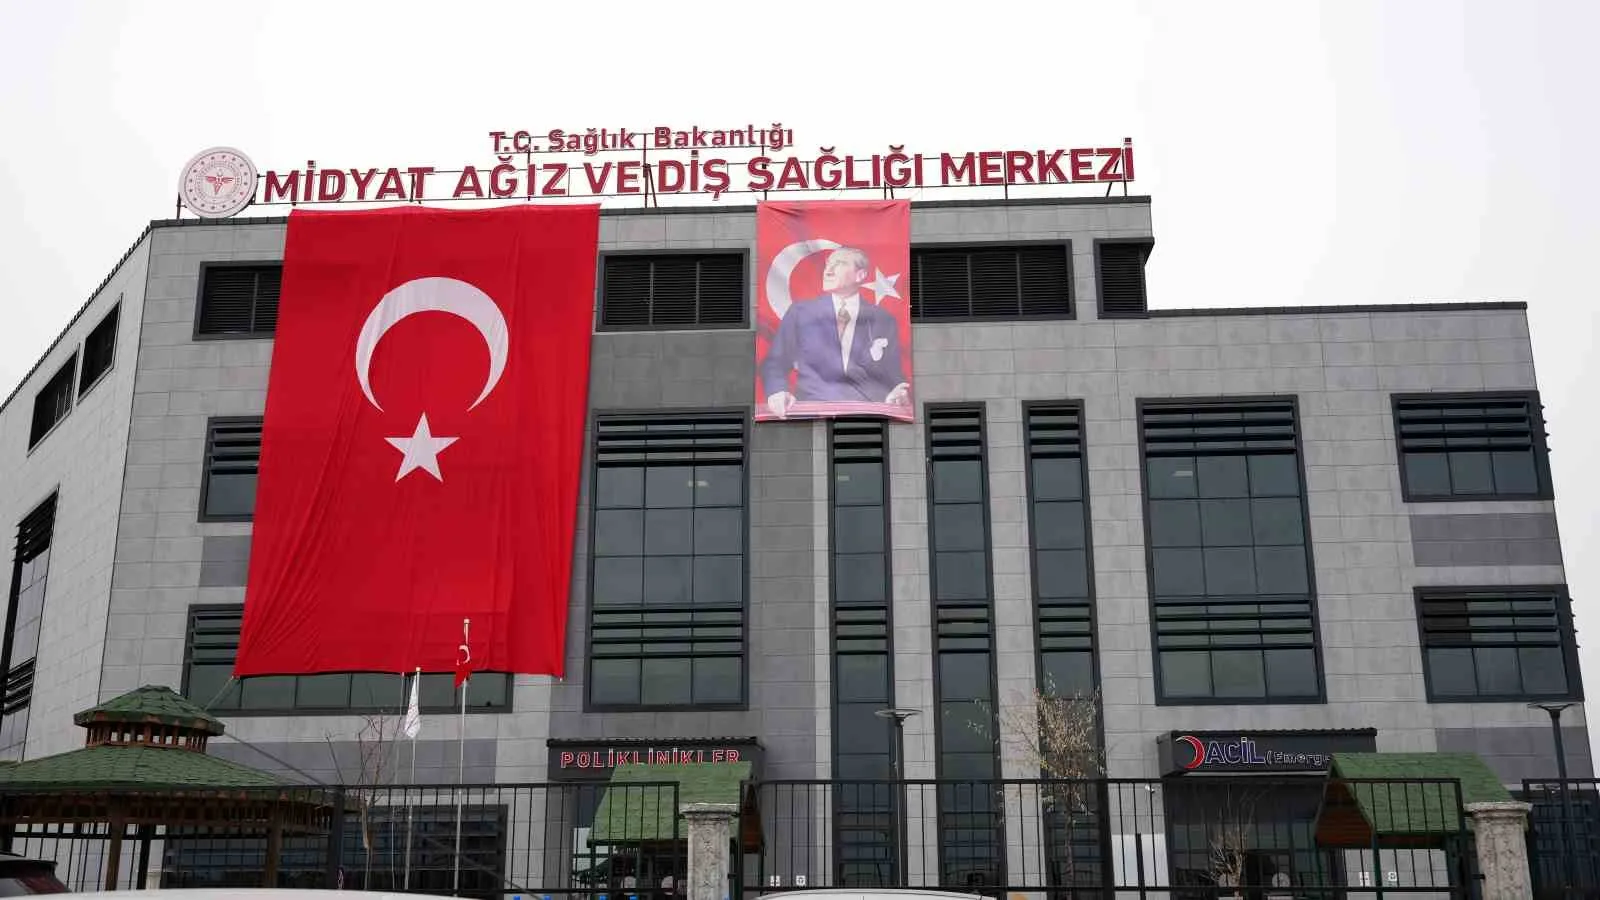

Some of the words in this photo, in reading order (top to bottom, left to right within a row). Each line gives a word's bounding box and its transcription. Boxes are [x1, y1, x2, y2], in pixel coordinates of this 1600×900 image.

[489, 131, 540, 152] T.C.
[548, 127, 635, 156] Sağlık
[654, 122, 793, 151] Bakanlığı
[263, 159, 435, 203] MİDYAT
[453, 156, 569, 200] AĞIZ
[583, 161, 641, 196] VE
[657, 150, 730, 201] DİŞ
[747, 145, 924, 191] SAĞLIĞI
[940, 137, 1136, 186] MERKEZİ
[1204, 736, 1265, 764] ACİL
